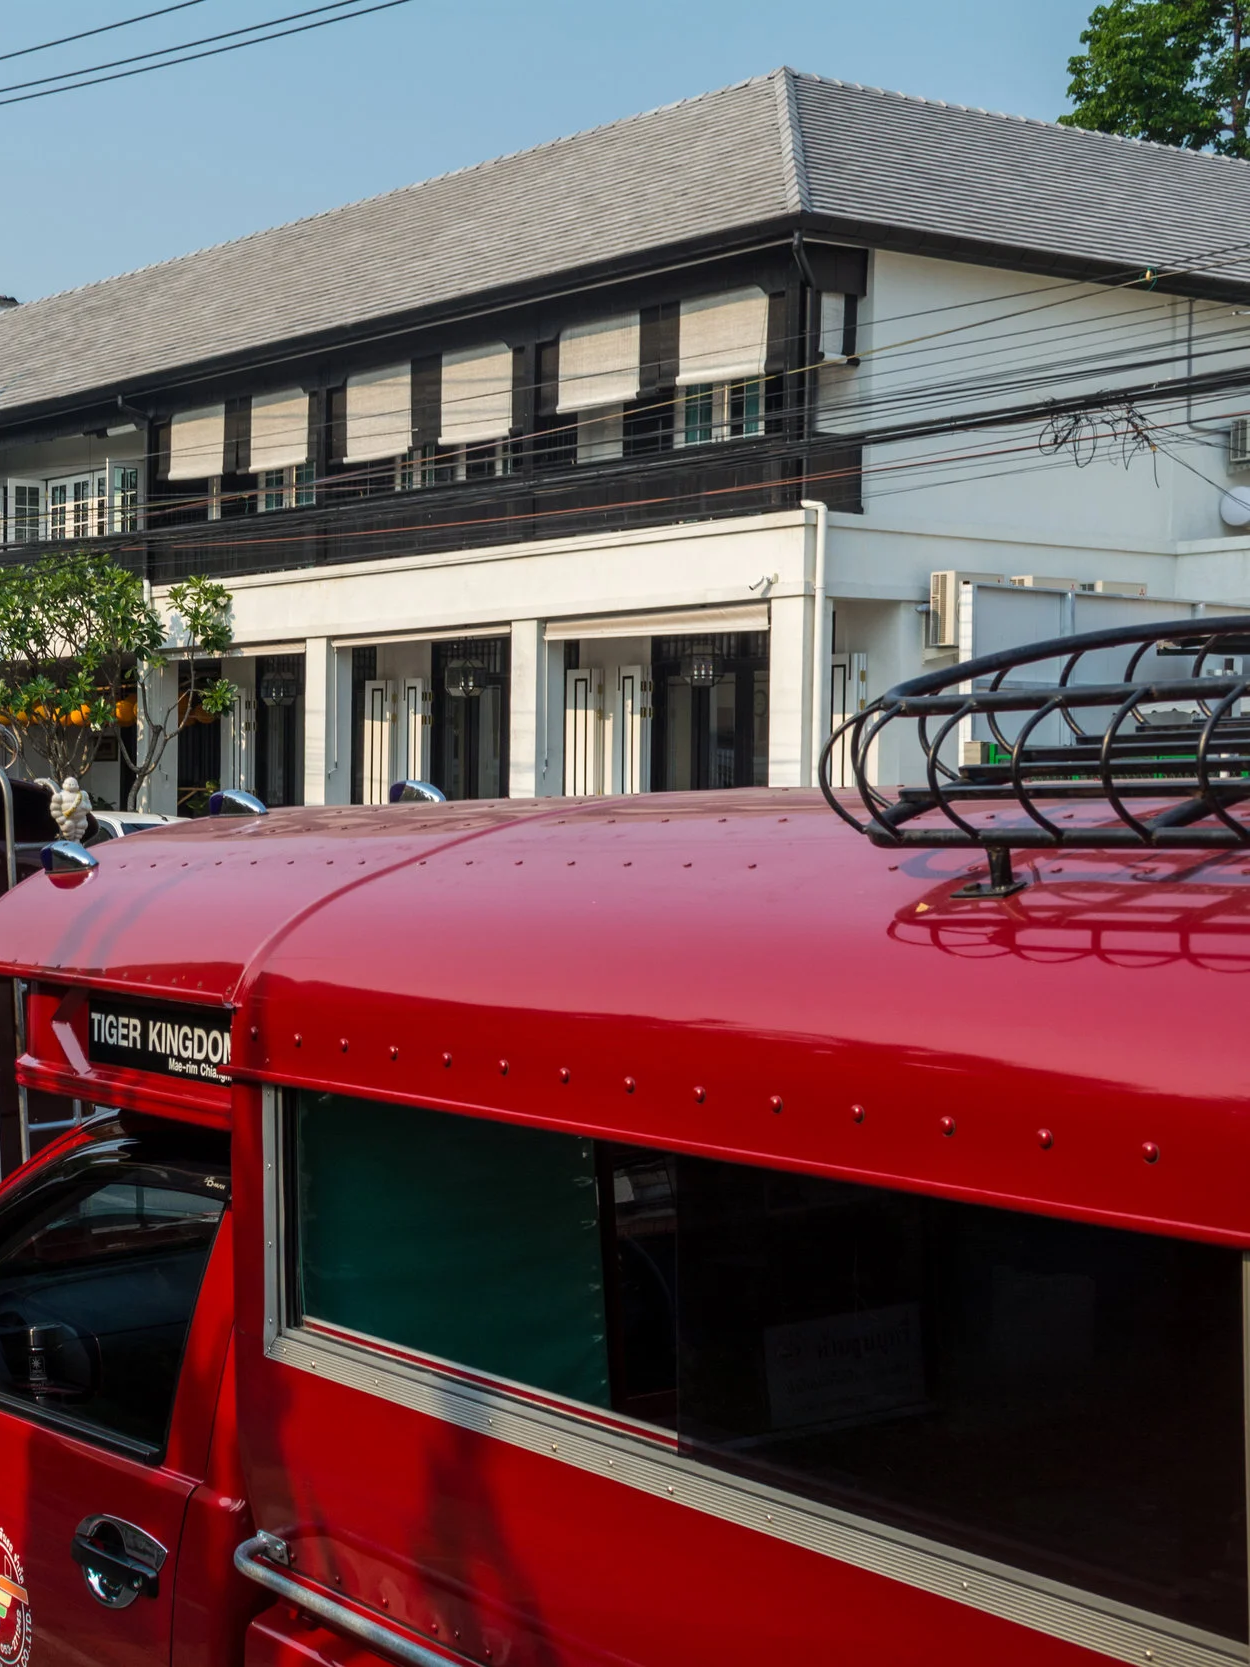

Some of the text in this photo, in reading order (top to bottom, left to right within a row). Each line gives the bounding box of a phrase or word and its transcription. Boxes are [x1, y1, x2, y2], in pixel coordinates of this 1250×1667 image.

[91, 1012, 141, 1049] TIGER
[168, 1057, 232, 1083] Mae-rim Chia
